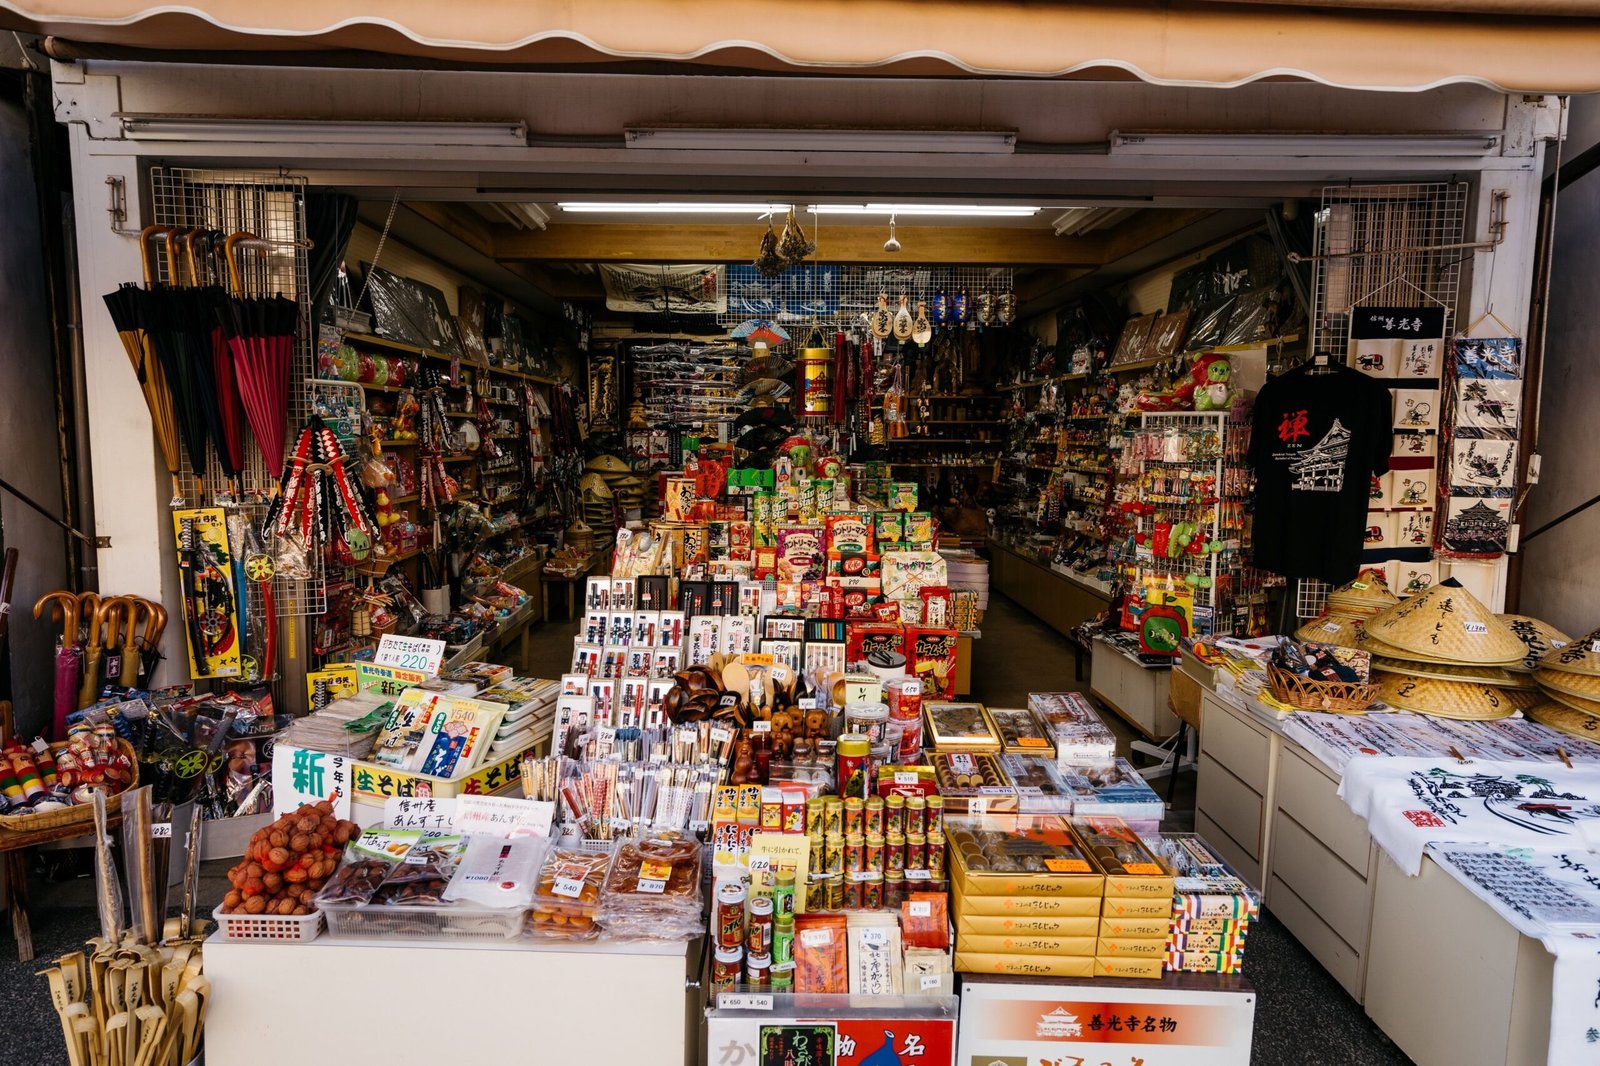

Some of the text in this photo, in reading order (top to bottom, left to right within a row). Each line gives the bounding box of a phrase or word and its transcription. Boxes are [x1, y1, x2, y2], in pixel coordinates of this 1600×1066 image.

[1278, 409, 1310, 442] 禅
[896, 561, 933, 571] じゃがりこ
[400, 654, 428, 670] 220
[451, 709, 475, 721] ¥540
[292, 747, 326, 798] 新
[357, 769, 415, 798] 生そば
[399, 800, 436, 813] 信州産
[1087, 1015, 1178, 1033] 善光寺名物
